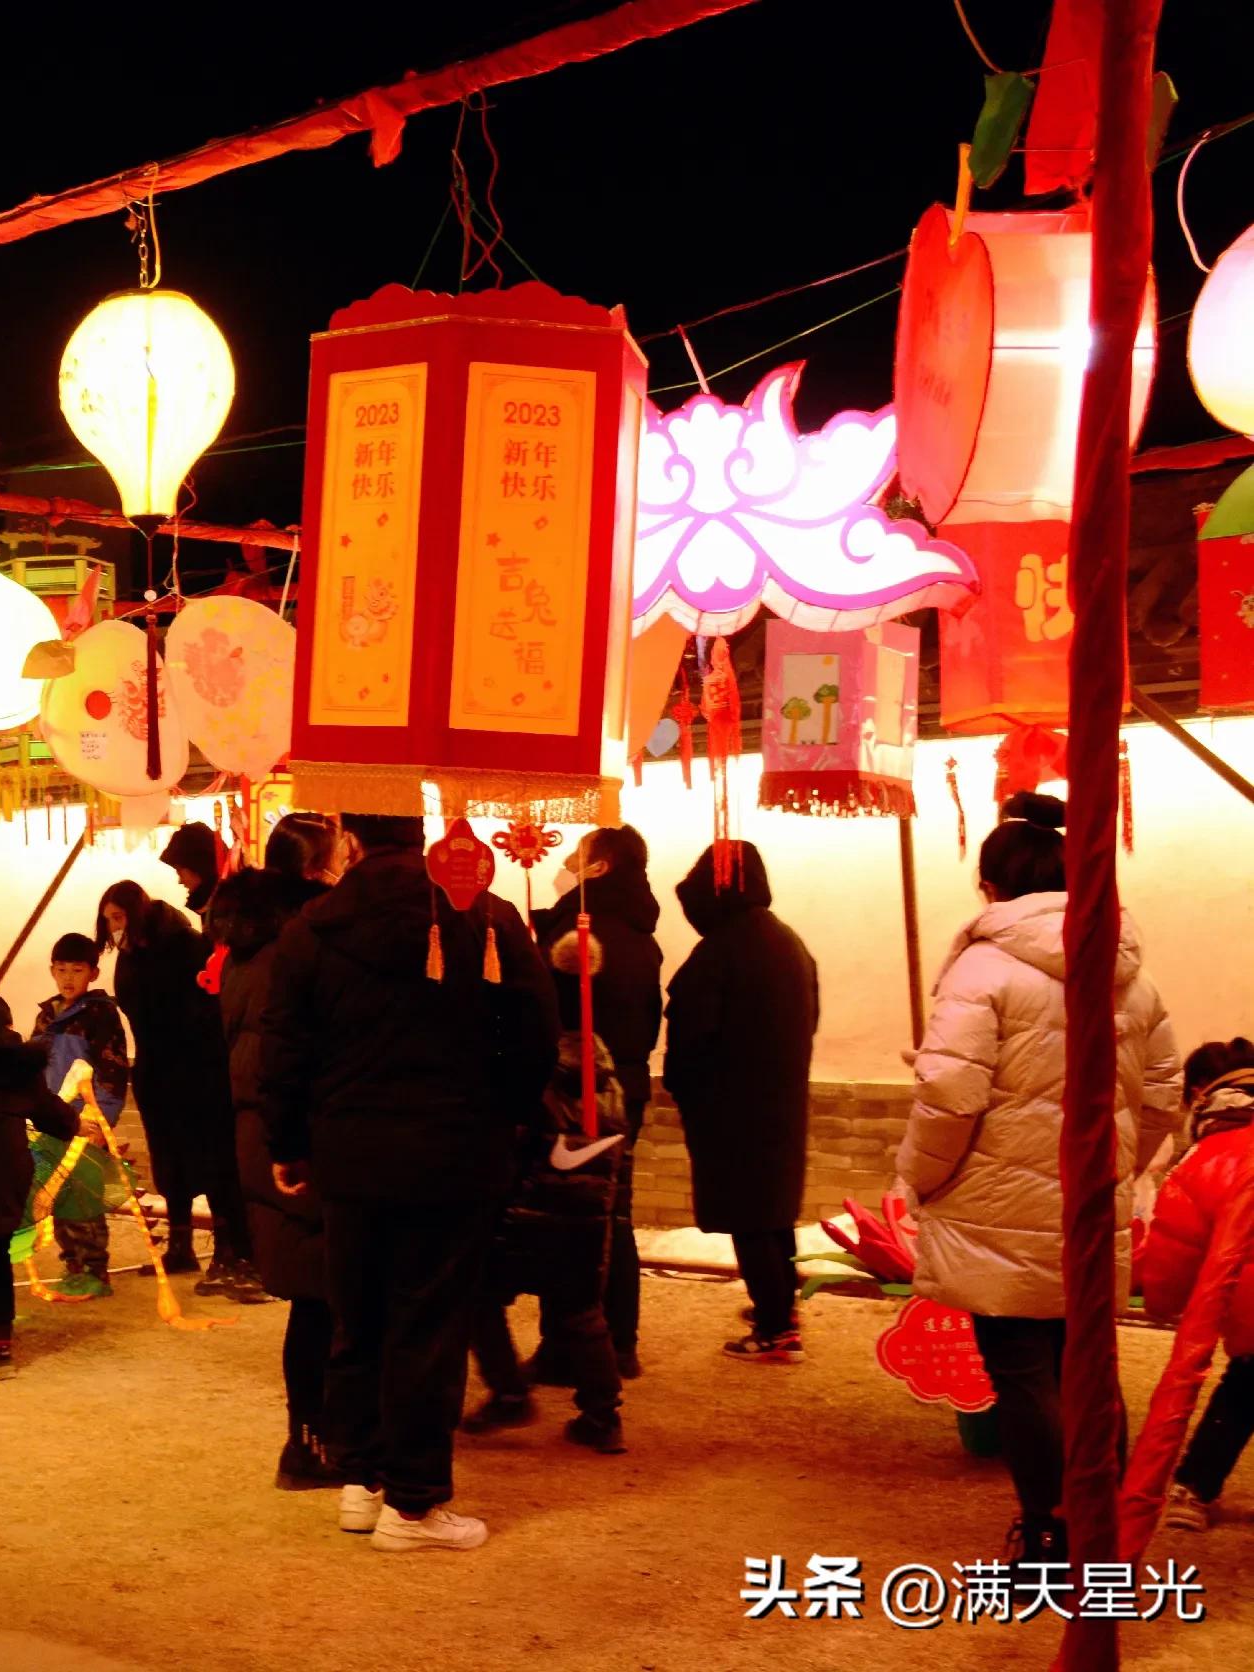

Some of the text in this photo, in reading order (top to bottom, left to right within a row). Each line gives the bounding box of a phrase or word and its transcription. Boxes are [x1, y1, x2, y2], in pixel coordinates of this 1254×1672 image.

[354, 402, 399, 428] 2023
[503, 401, 561, 427] 2023
[354, 439, 395, 468] 新年
[503, 439, 557, 468] 新年
[352, 471, 394, 500] 快乐
[500, 471, 556, 500] 快乐
